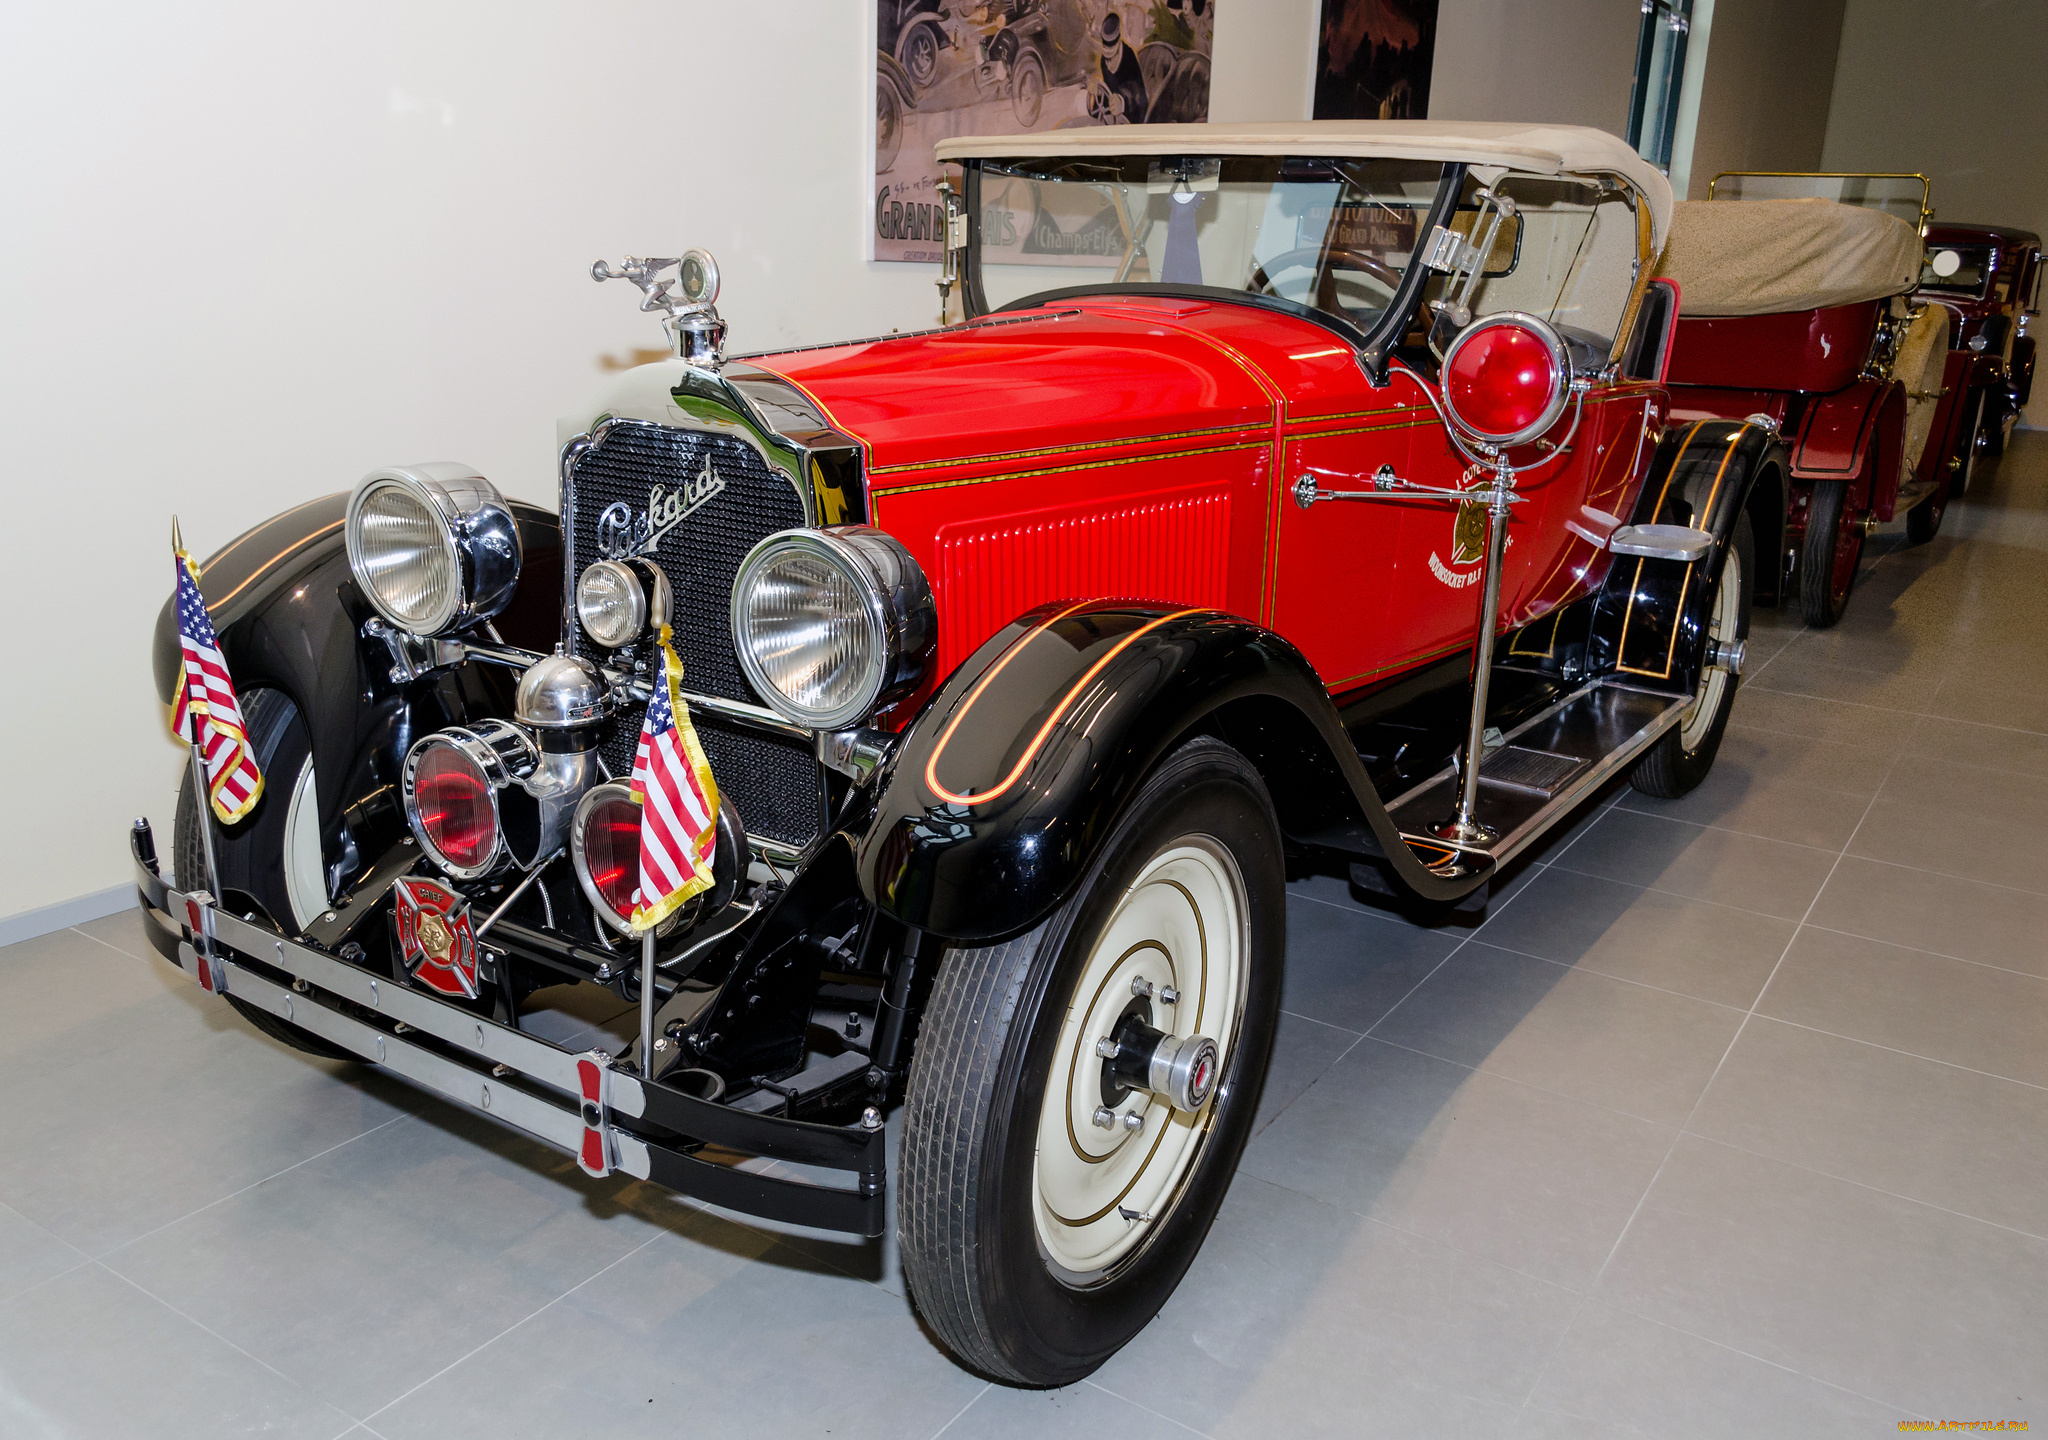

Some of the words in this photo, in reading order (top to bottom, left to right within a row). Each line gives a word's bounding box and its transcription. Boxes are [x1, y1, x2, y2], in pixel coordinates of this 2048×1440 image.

[876, 185, 944, 242] GRAND
[598, 453, 725, 559] Packard
[419, 887, 443, 903] CHIEF
